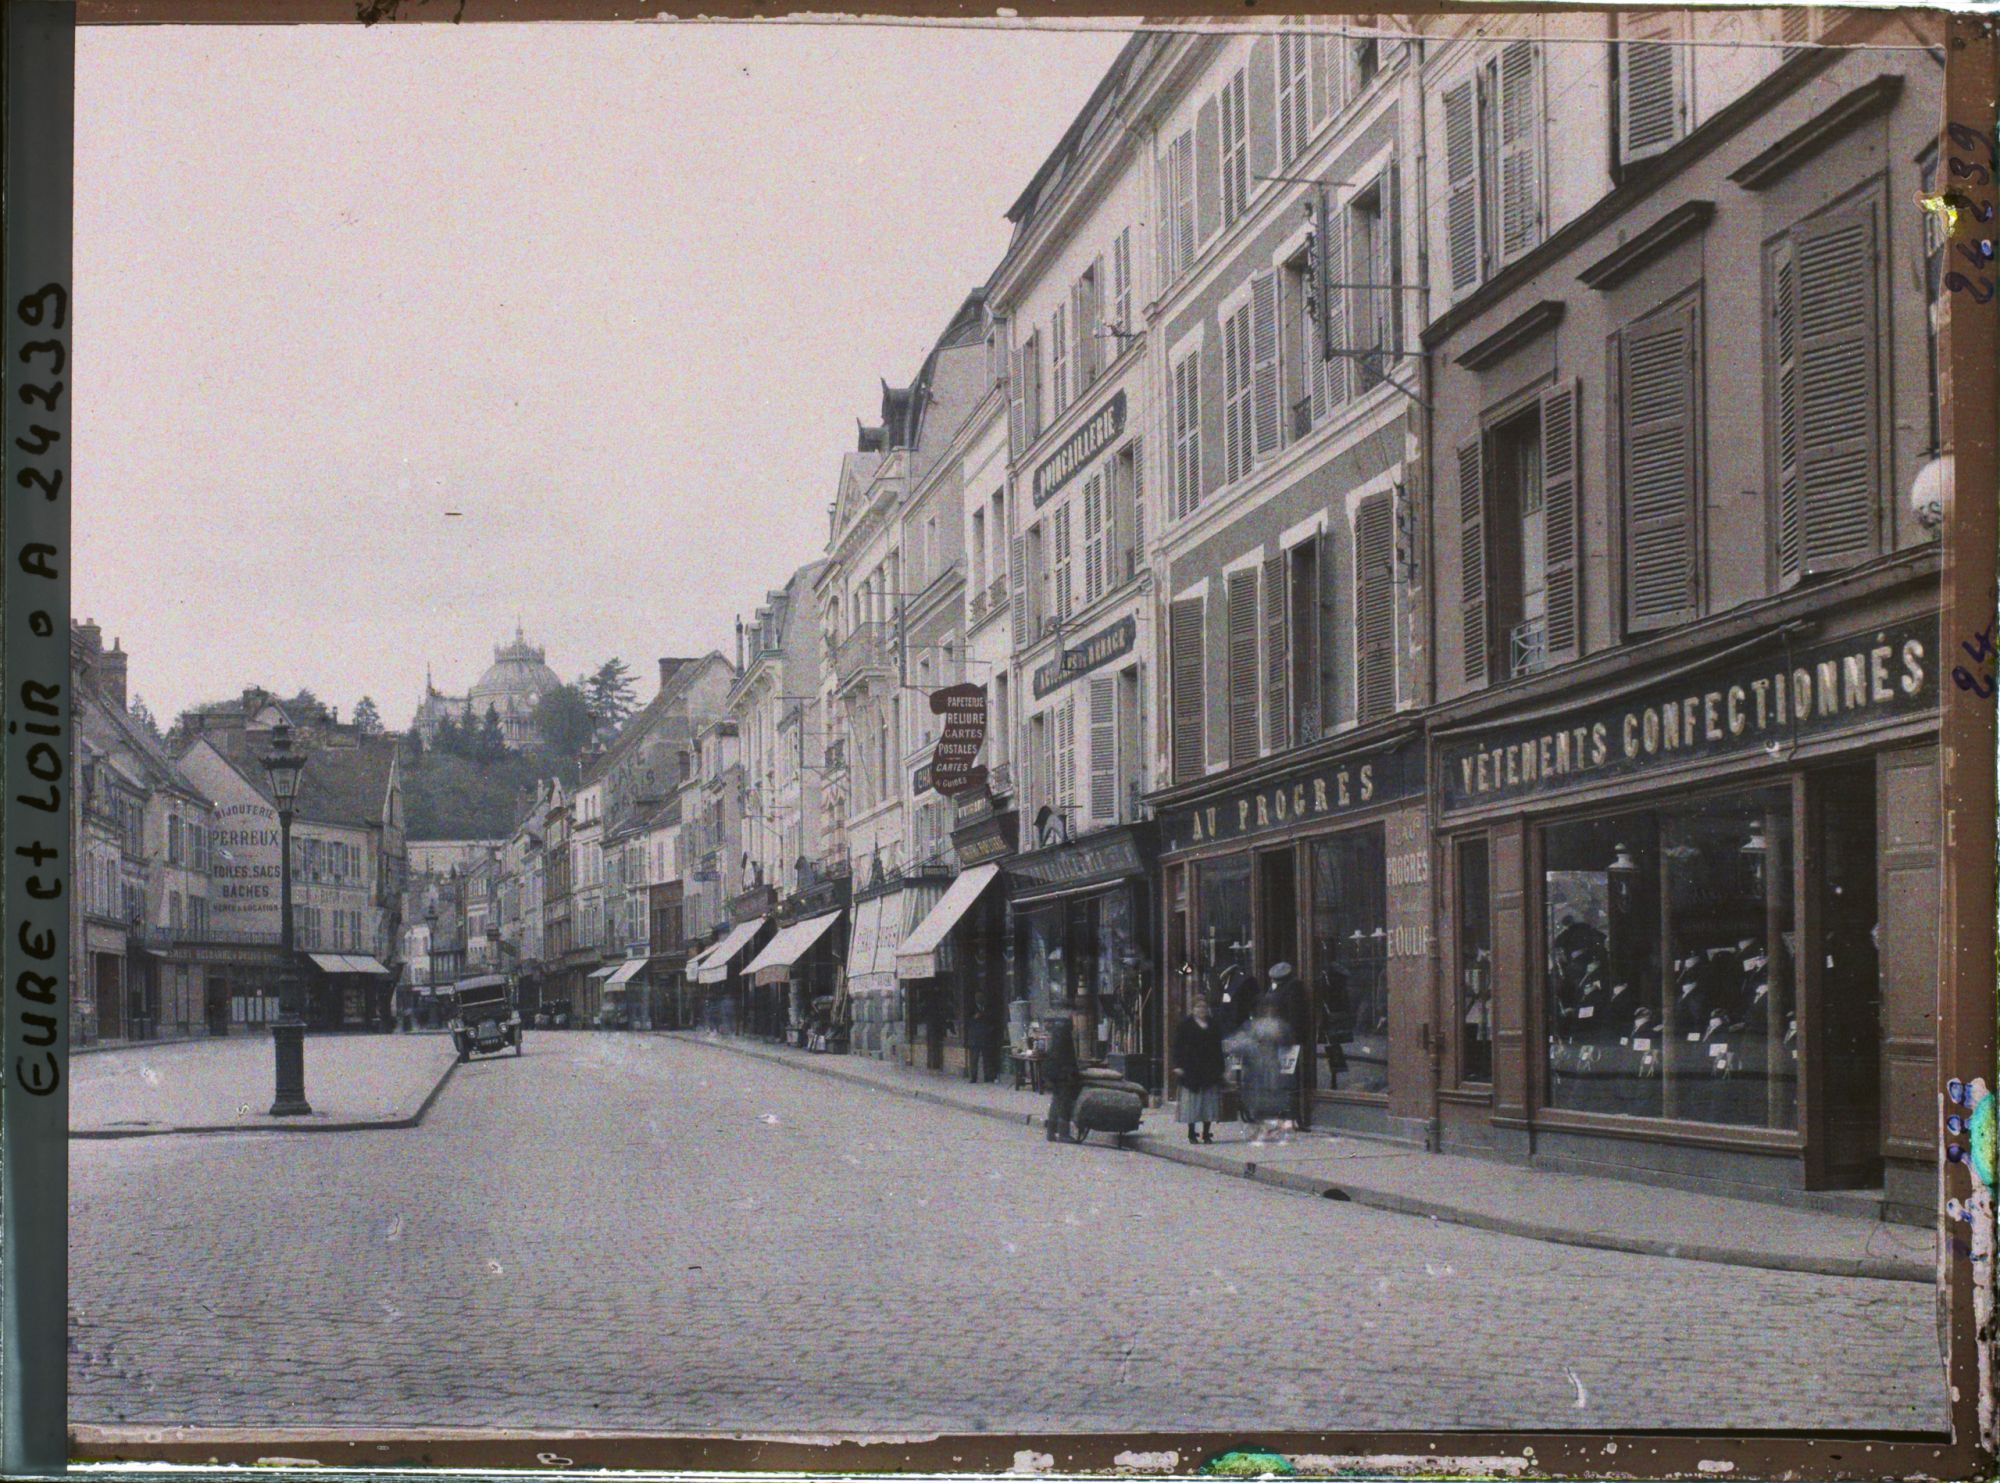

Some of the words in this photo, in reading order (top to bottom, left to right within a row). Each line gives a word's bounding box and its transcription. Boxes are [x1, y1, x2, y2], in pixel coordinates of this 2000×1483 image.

[15, 281, 68, 502] 24239
[1039, 405, 1116, 499] QUINCAILLERIE
[18, 541, 59, 580] A
[947, 696, 985, 708] PAPETERIE
[947, 712, 986, 725] RELIURE
[1461, 722, 1607, 795] VÊTEMENTS
[1622, 632, 1925, 759] CONFECTIONNÉS
[944, 728, 983, 739] CARTES
[938, 743, 978, 756] POSTALES
[935, 762, 969, 773] CARTES
[213, 803, 275, 821] BIJOUTERIE
[1191, 806, 1217, 841] AU
[212, 829, 279, 847] PERREUX
